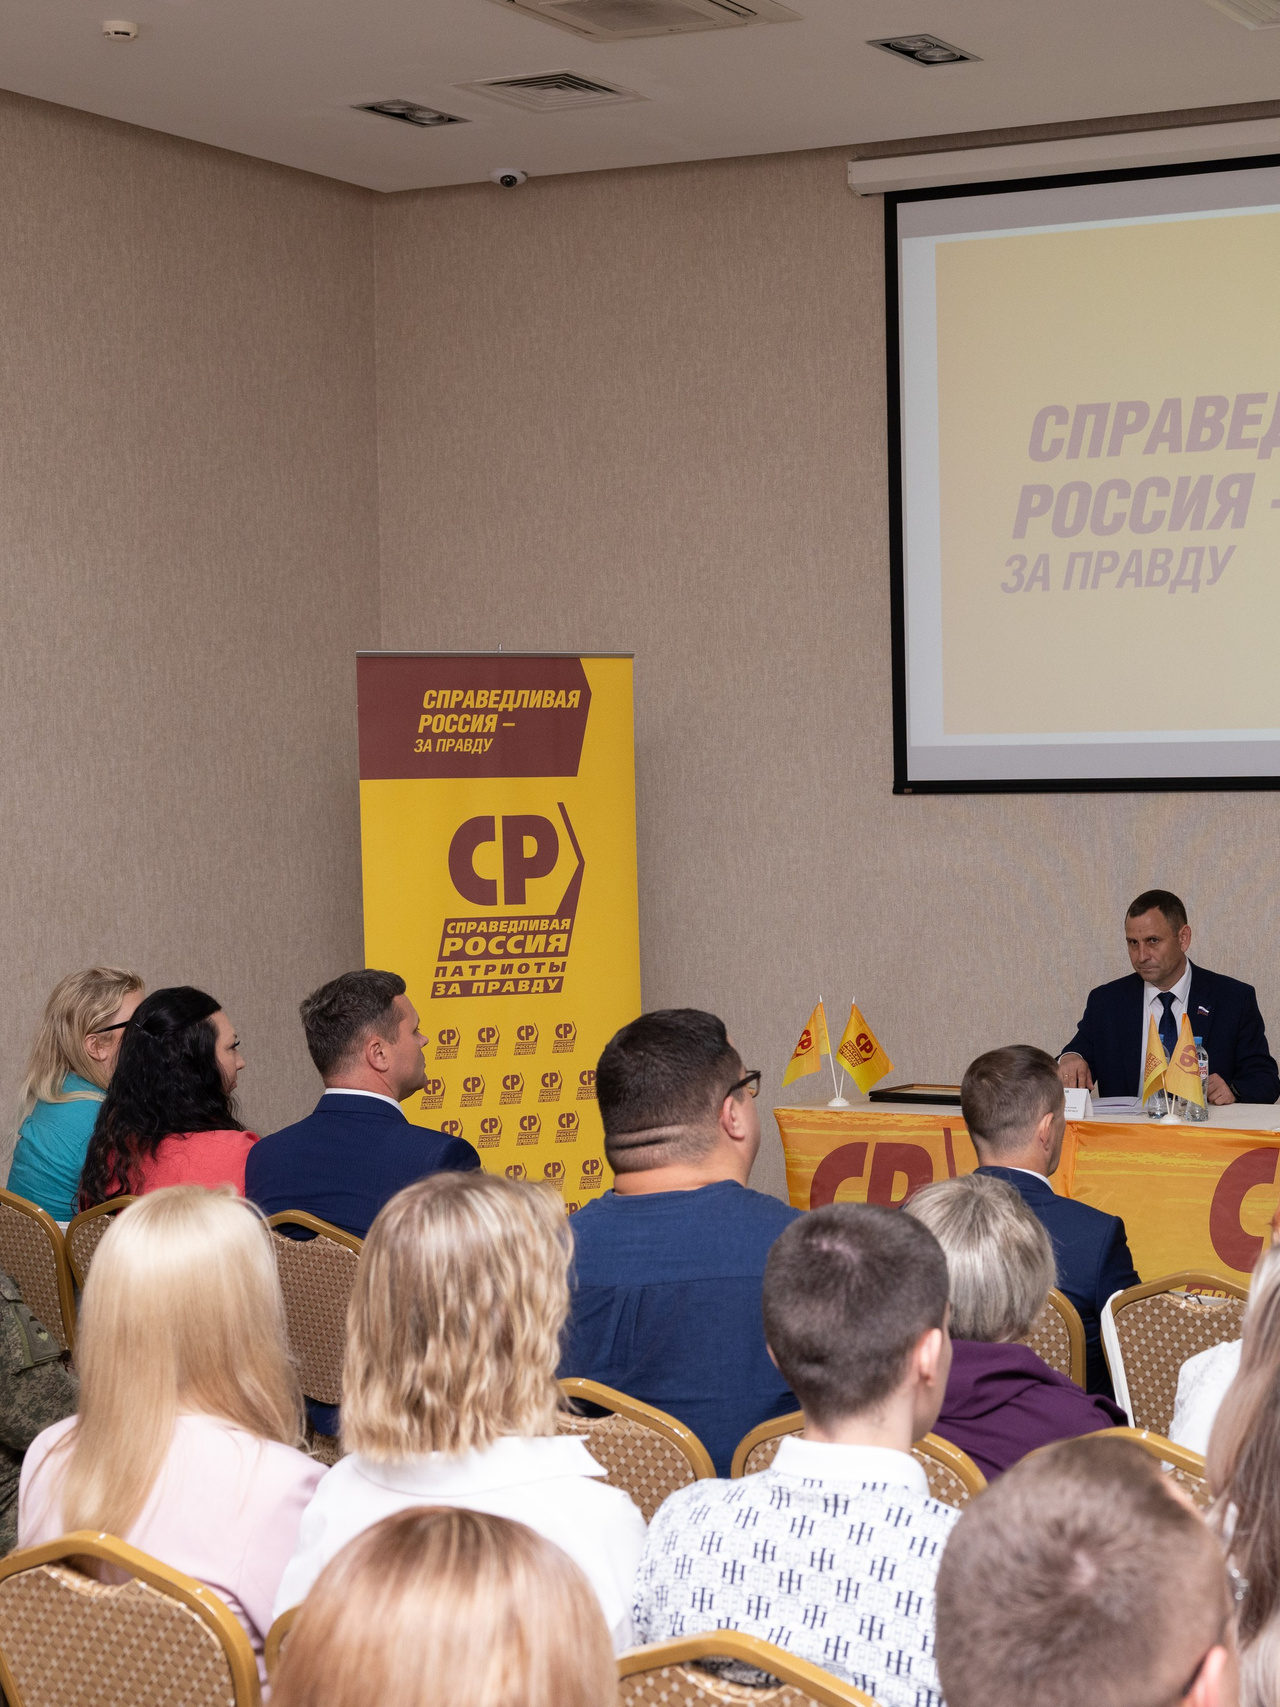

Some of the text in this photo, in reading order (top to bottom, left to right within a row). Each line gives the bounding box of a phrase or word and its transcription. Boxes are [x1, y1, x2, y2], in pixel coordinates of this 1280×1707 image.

[1012, 472, 1255, 539] РОССИЯ
[1000, 545, 1236, 594] ЗА ПРАВДУ
[423, 690, 580, 711] СПРАВЕДЛИВАЯ
[418, 714, 498, 733] РОССИЯ
[414, 738, 493, 754] ЗА ПРАВДУ
[448, 814, 559, 906] СР
[447, 919, 571, 934] СПРАВЕДЛИВАЯ
[442, 934, 568, 957] РОССИЯ
[434, 962, 566, 978] ПАТРИОТЫ
[435, 979, 560, 995] ЗА ПРАВДУ
